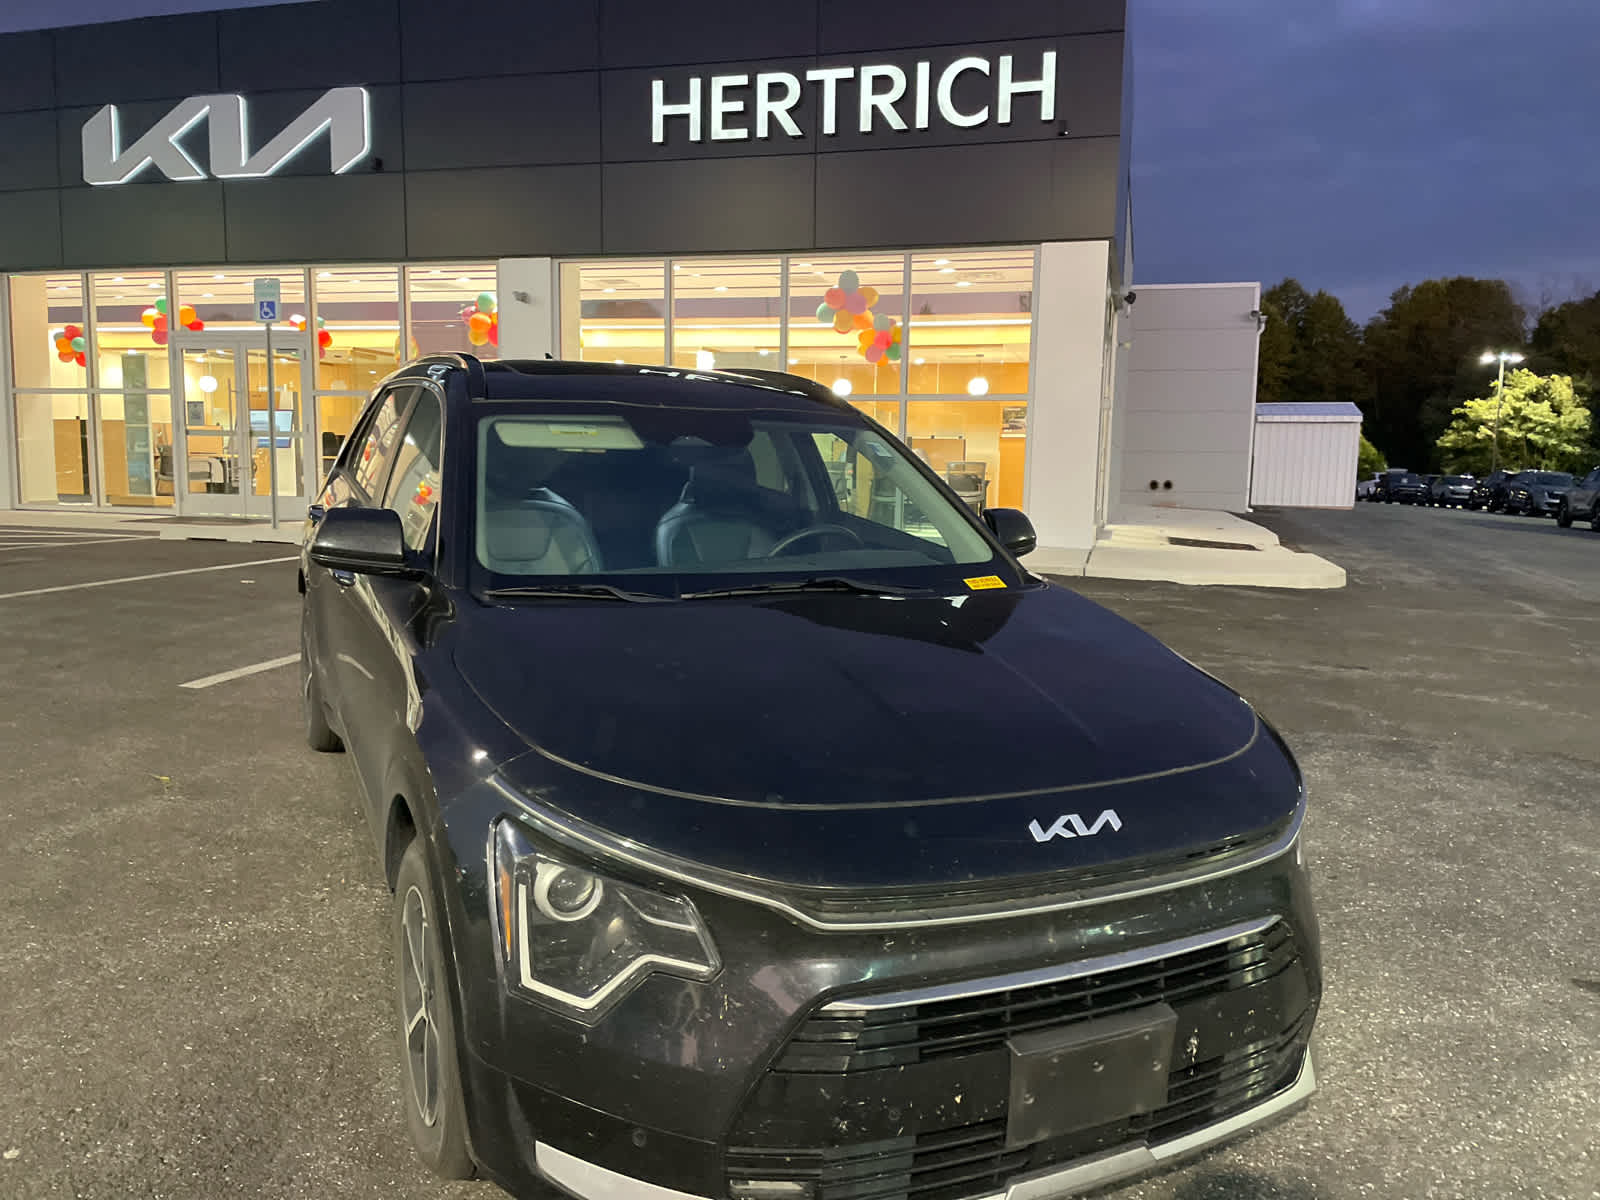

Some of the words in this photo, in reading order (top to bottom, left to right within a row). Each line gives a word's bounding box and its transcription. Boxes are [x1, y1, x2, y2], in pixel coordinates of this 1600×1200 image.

[82, 87, 370, 186] KIA
[651, 51, 1057, 143] HERTRICH
[1028, 809, 1122, 843] KIA
